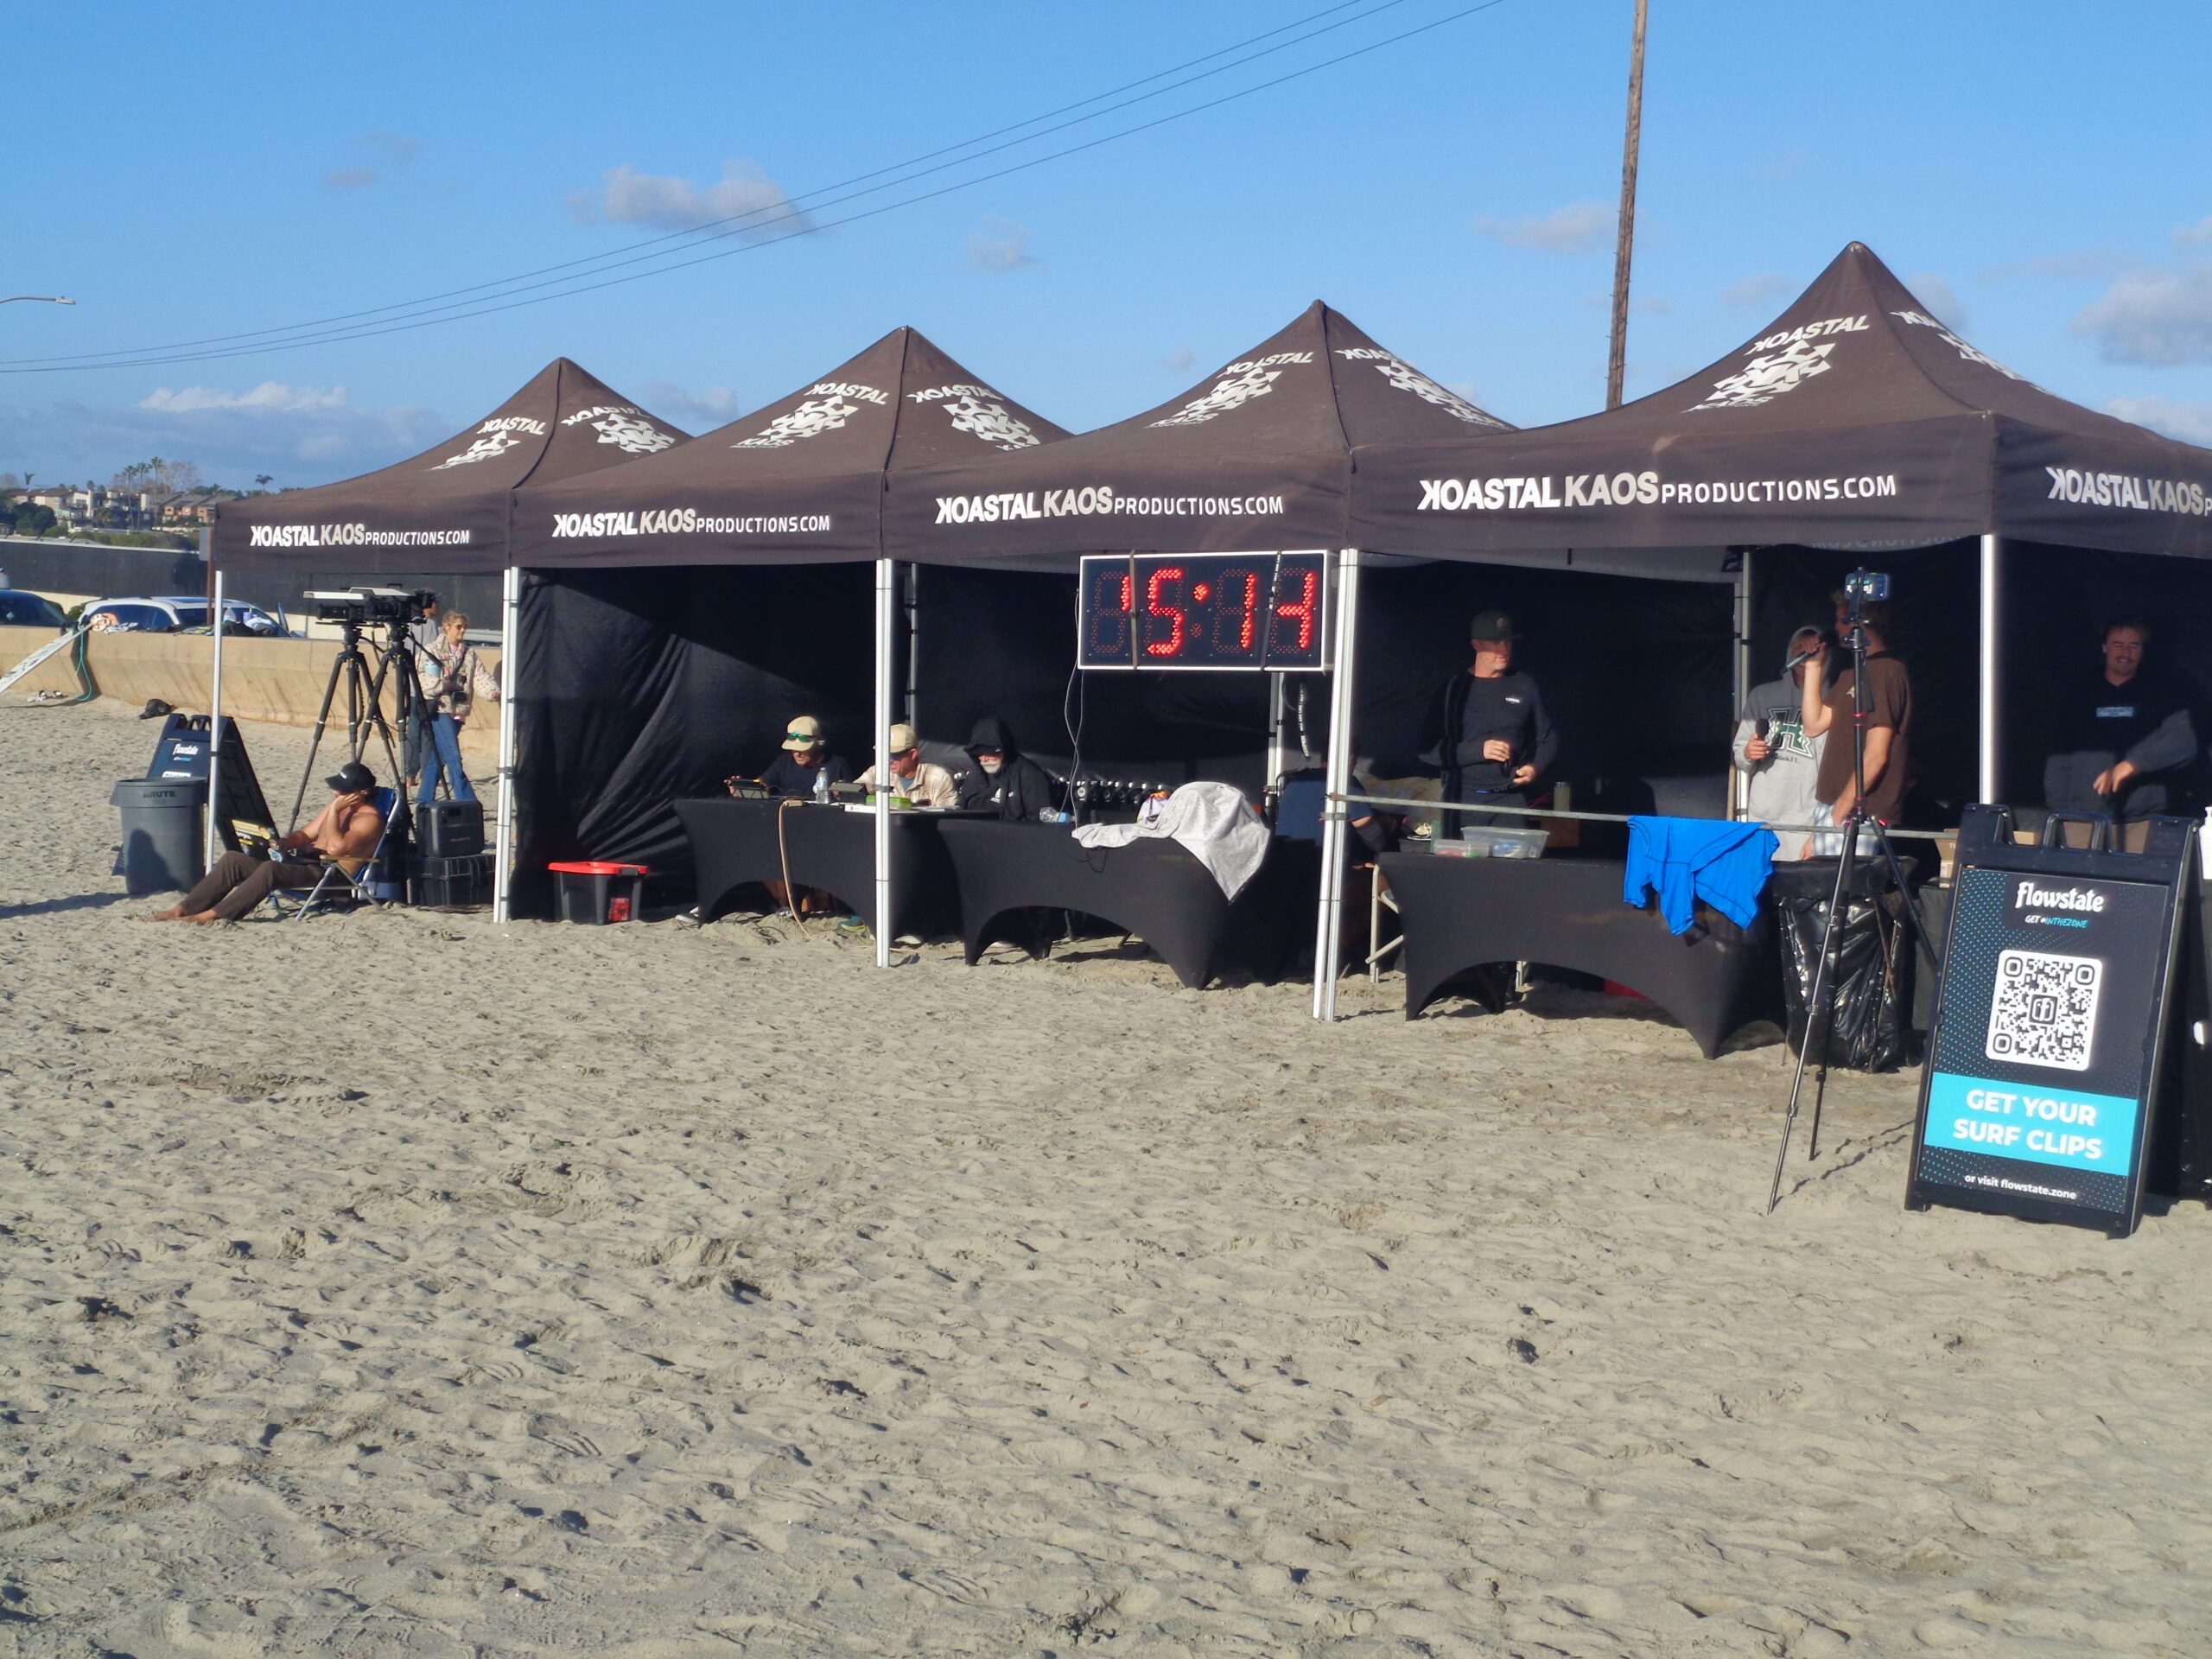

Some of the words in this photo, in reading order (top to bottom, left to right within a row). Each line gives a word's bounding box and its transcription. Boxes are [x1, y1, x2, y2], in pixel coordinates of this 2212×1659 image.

[2015, 881, 2105, 912] flowstate
[2024, 915, 2041, 924] GET
[1966, 1089, 2018, 1115] GET
[2022, 1096, 2097, 1127] YOUR
[1953, 1118, 2021, 1147] SURF
[2025, 1129, 2102, 1160] CLIPS
[1977, 1175, 1999, 1187] visit
[2000, 1179, 2076, 1199] flowstate.zone
